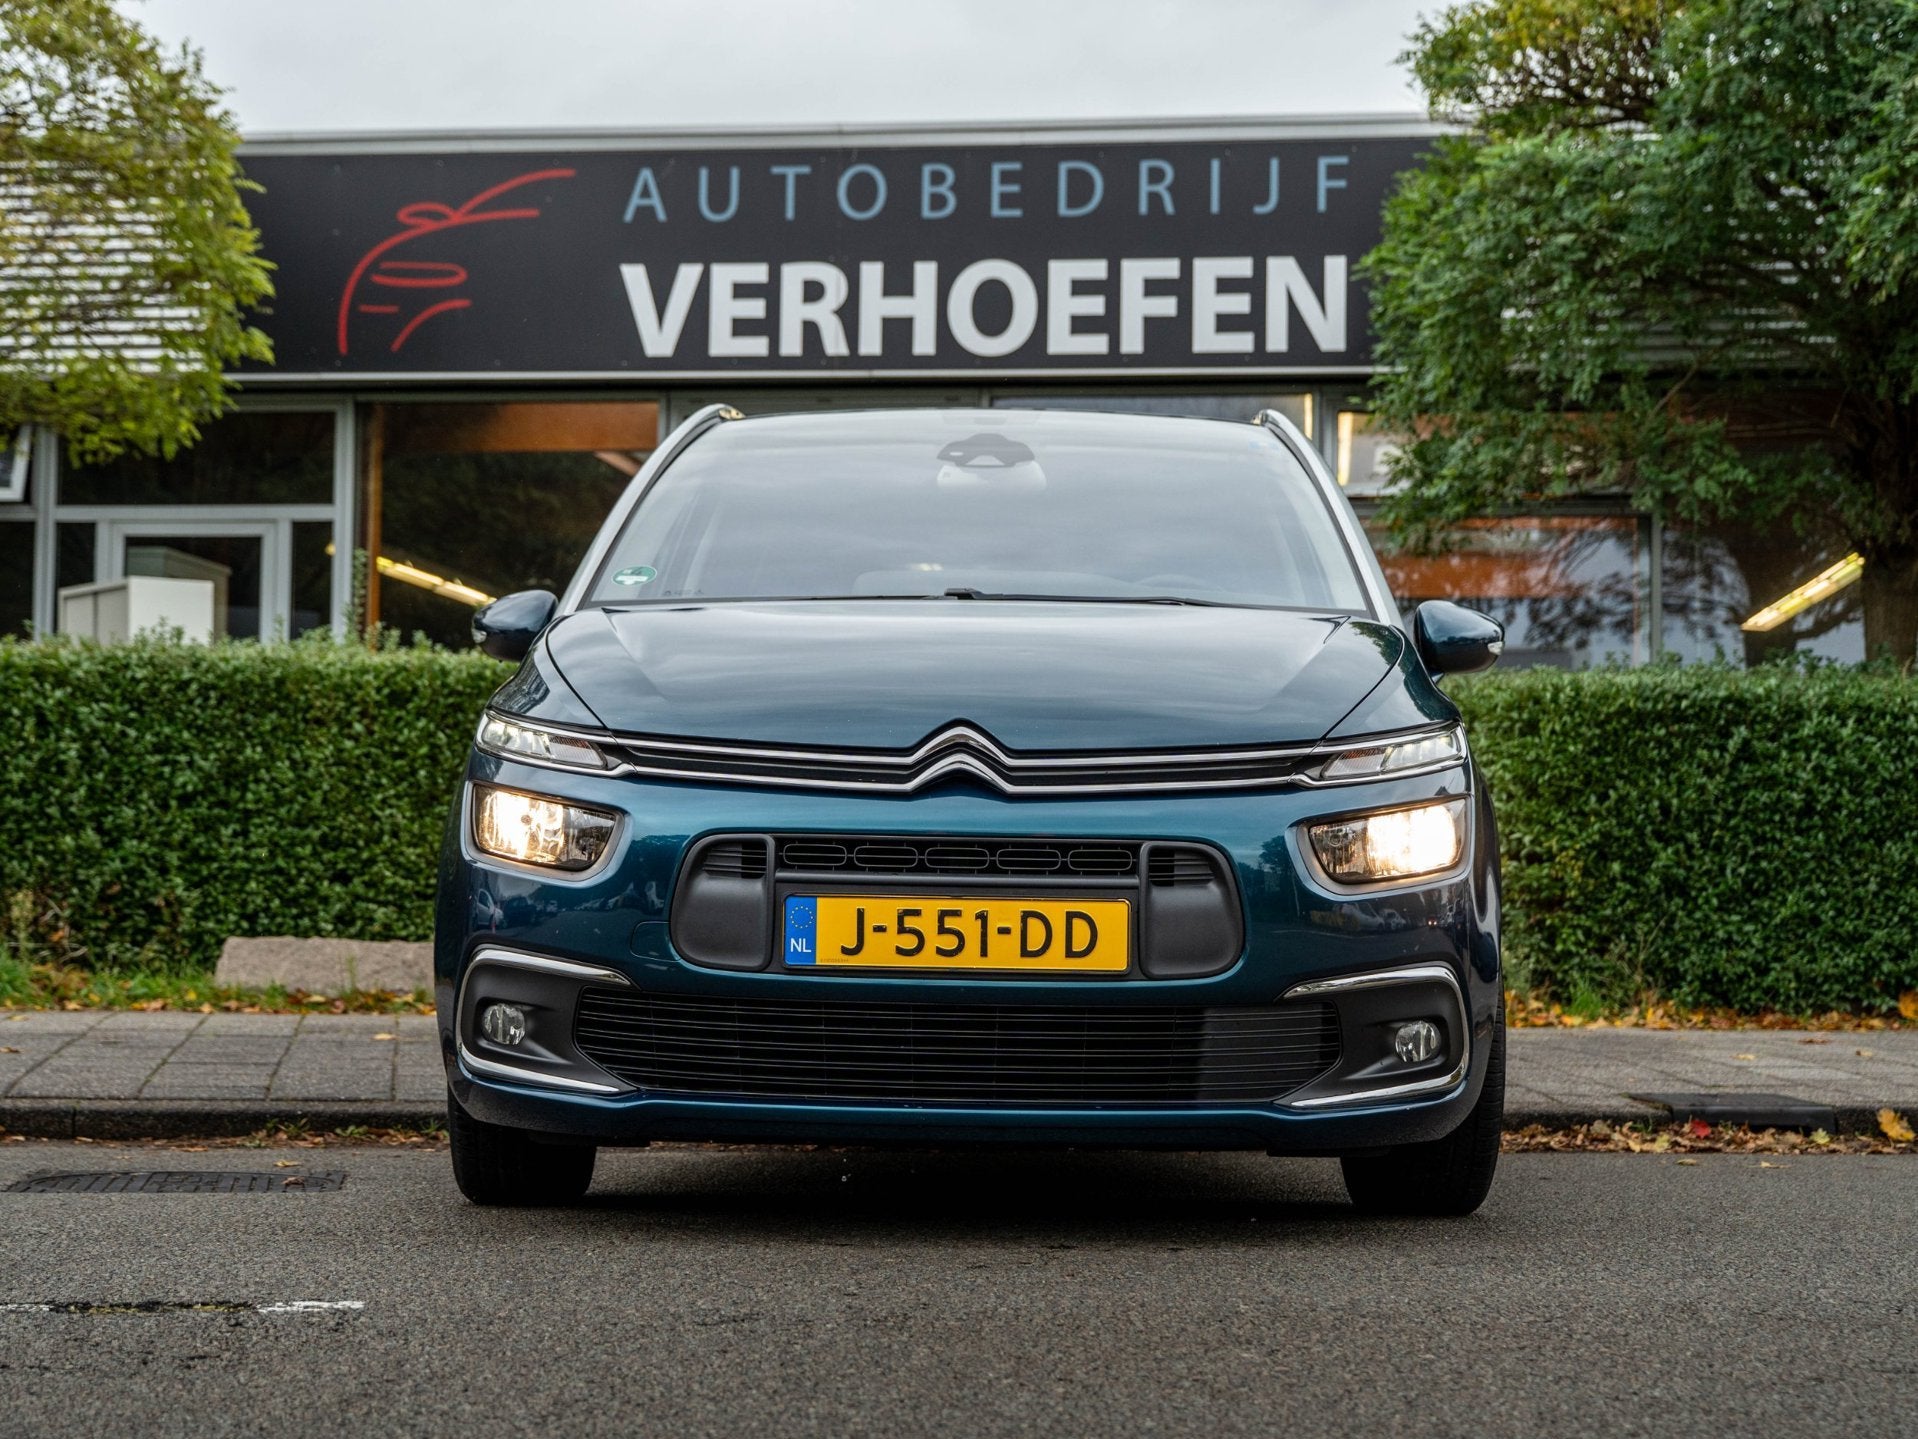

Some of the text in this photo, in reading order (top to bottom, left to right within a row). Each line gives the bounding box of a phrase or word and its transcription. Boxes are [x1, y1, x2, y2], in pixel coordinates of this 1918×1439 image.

[623, 156, 1349, 222] AUTOBEDRIJF
[619, 255, 1348, 358] VERHOEFEN
[789, 938, 811, 953] NL
[840, 907, 1099, 959] J-551-DD
